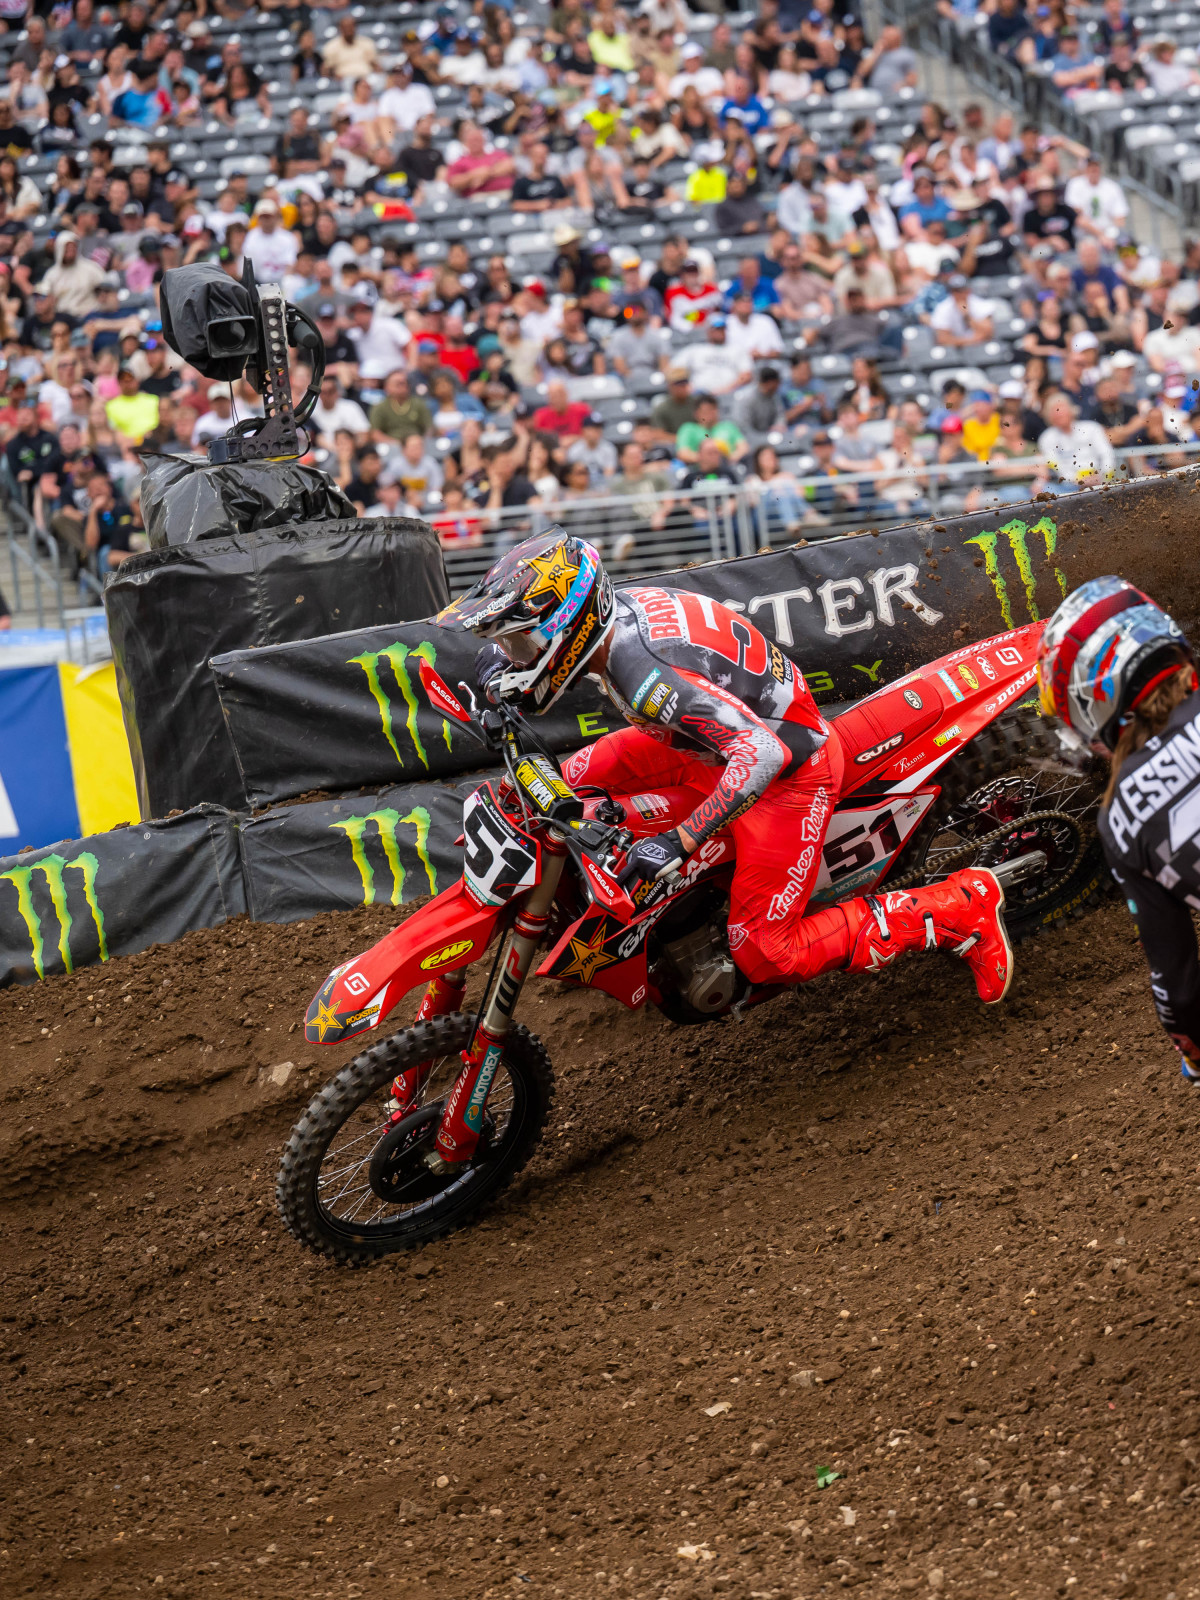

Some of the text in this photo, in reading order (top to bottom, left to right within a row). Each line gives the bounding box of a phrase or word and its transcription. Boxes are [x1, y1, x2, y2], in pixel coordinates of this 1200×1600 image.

[546, 573, 590, 633] OAKLEY
[552, 612, 598, 686] ROCKSTAR
[430, 680, 461, 712] GASGAS
[633, 670, 660, 703] MOTOREX
[660, 691, 679, 724] WP
[856, 735, 903, 763] GUTS
[893, 752, 926, 773] PARADISE
[517, 763, 556, 810] PROTAPER
[465, 805, 534, 901] 51
[823, 809, 901, 883] 51
[588, 863, 615, 898] GASGAS
[644, 880, 665, 904] ENERGY
[767, 880, 803, 921] Troy
[787, 845, 814, 882] Lee
[1042, 878, 1098, 924] DUNLOP
[422, 939, 473, 970] FMF
[346, 1004, 380, 1026] ROCKSTAR
[472, 1051, 500, 1104] MOTOREX
